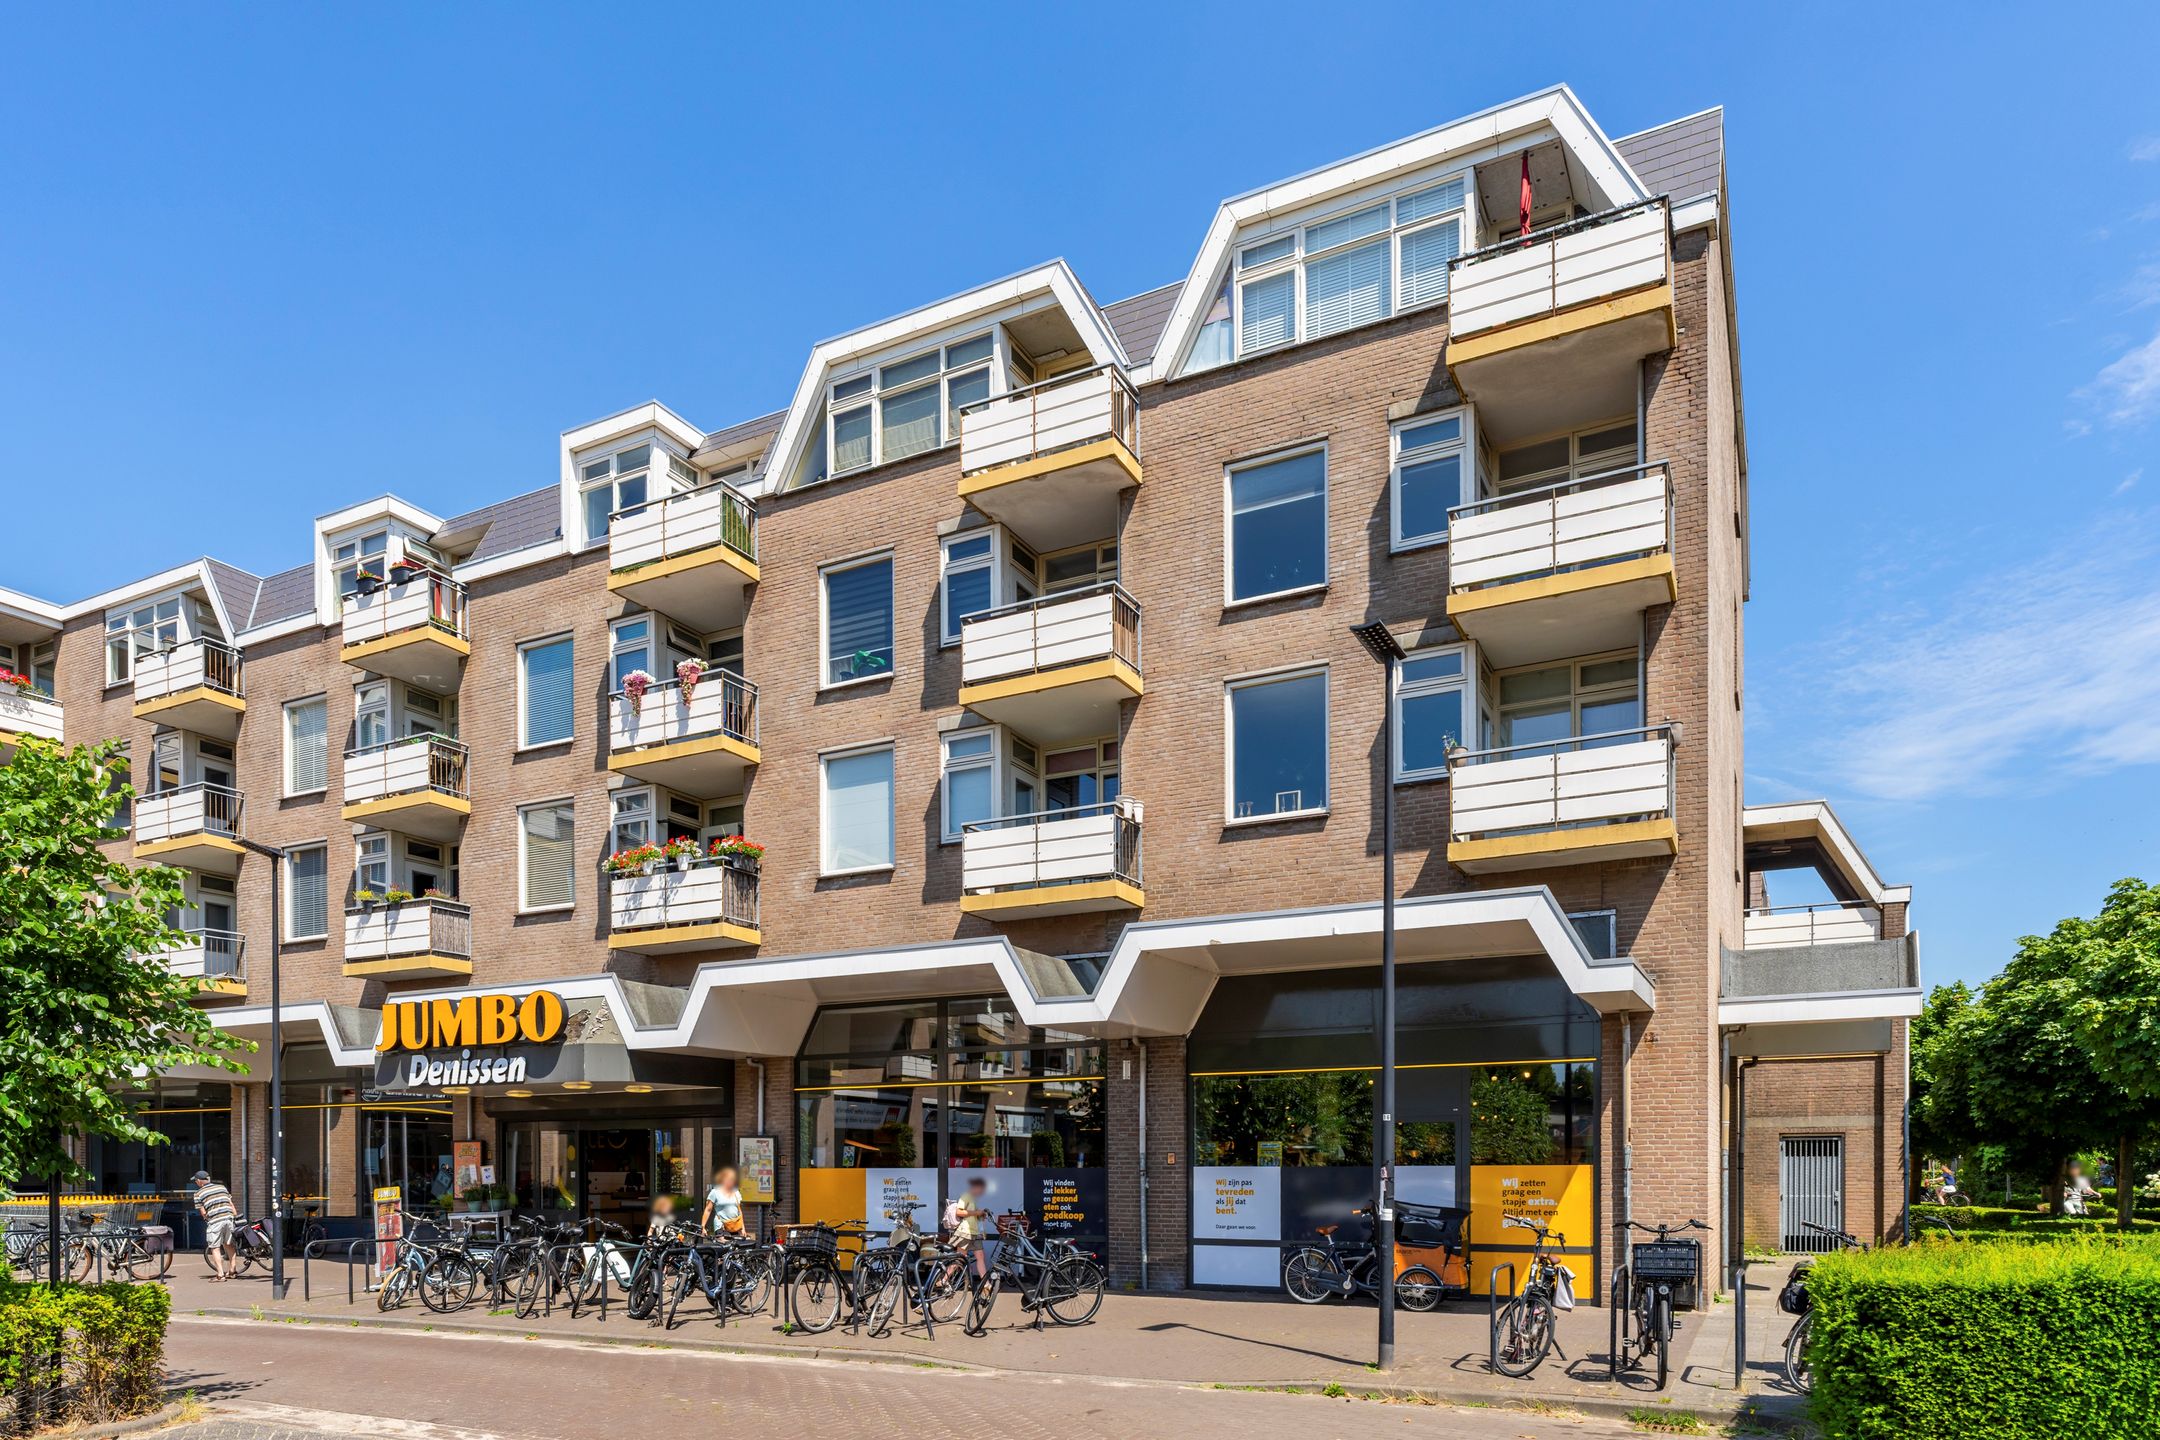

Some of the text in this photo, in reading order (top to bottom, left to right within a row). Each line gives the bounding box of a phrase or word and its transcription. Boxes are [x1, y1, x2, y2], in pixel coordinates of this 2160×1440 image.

[376, 990, 566, 1052] JUMBO
[408, 1049, 527, 1087] Denissen
[883, 1178, 895, 1187] Wij
[1043, 1179, 1054, 1188] Wij
[1216, 1179, 1227, 1187] Wij
[1228, 1179, 1240, 1187] zijn
[1502, 1178, 1518, 1189] Wij
[1216, 1188, 1255, 1196] tevreden
[1502, 1190, 1525, 1198] graag
[1052, 1195, 1078, 1204] gezond
[1225, 1197, 1235, 1207] jij
[1502, 1197, 1558, 1207] stapje extra.
[1043, 1203, 1059, 1211] eten
[1216, 1206, 1238, 1215] bent.
[1043, 1211, 1085, 1222] goedkoop
[1502, 1208, 1524, 1217] Altijd
[1525, 1208, 1542, 1216] met
[1060, 1220, 1073, 1230] zijn.
